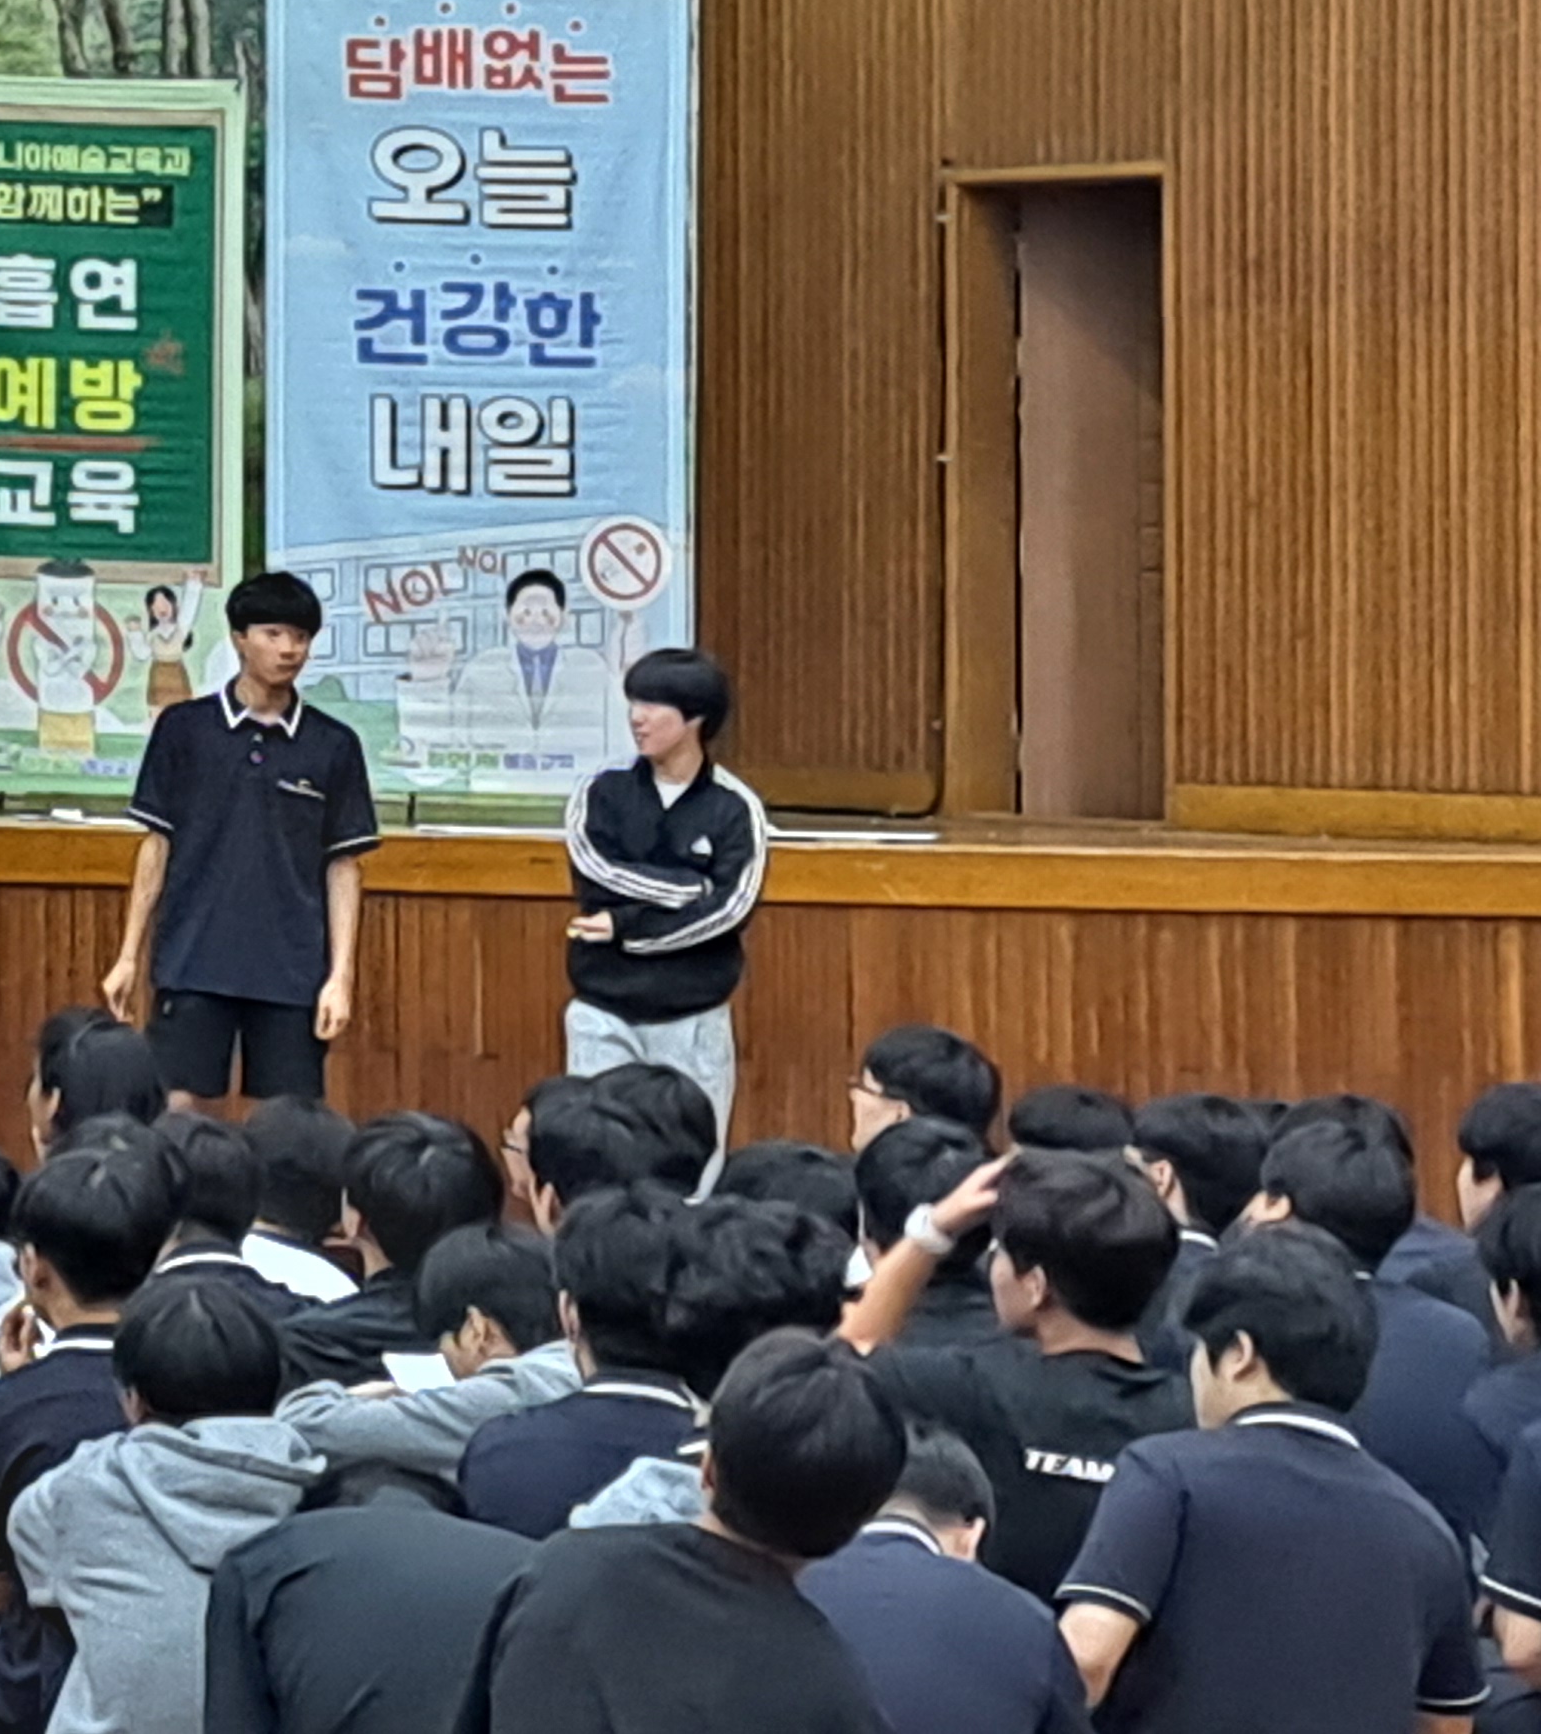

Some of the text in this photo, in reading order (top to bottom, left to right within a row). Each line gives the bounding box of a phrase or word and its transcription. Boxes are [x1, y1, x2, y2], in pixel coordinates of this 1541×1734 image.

[345, 27, 611, 104] 담배없는
[367, 125, 577, 231] 오늘
[353, 280, 603, 368] 건강한
[369, 392, 578, 498] 내일
[363, 561, 455, 624] NO!
